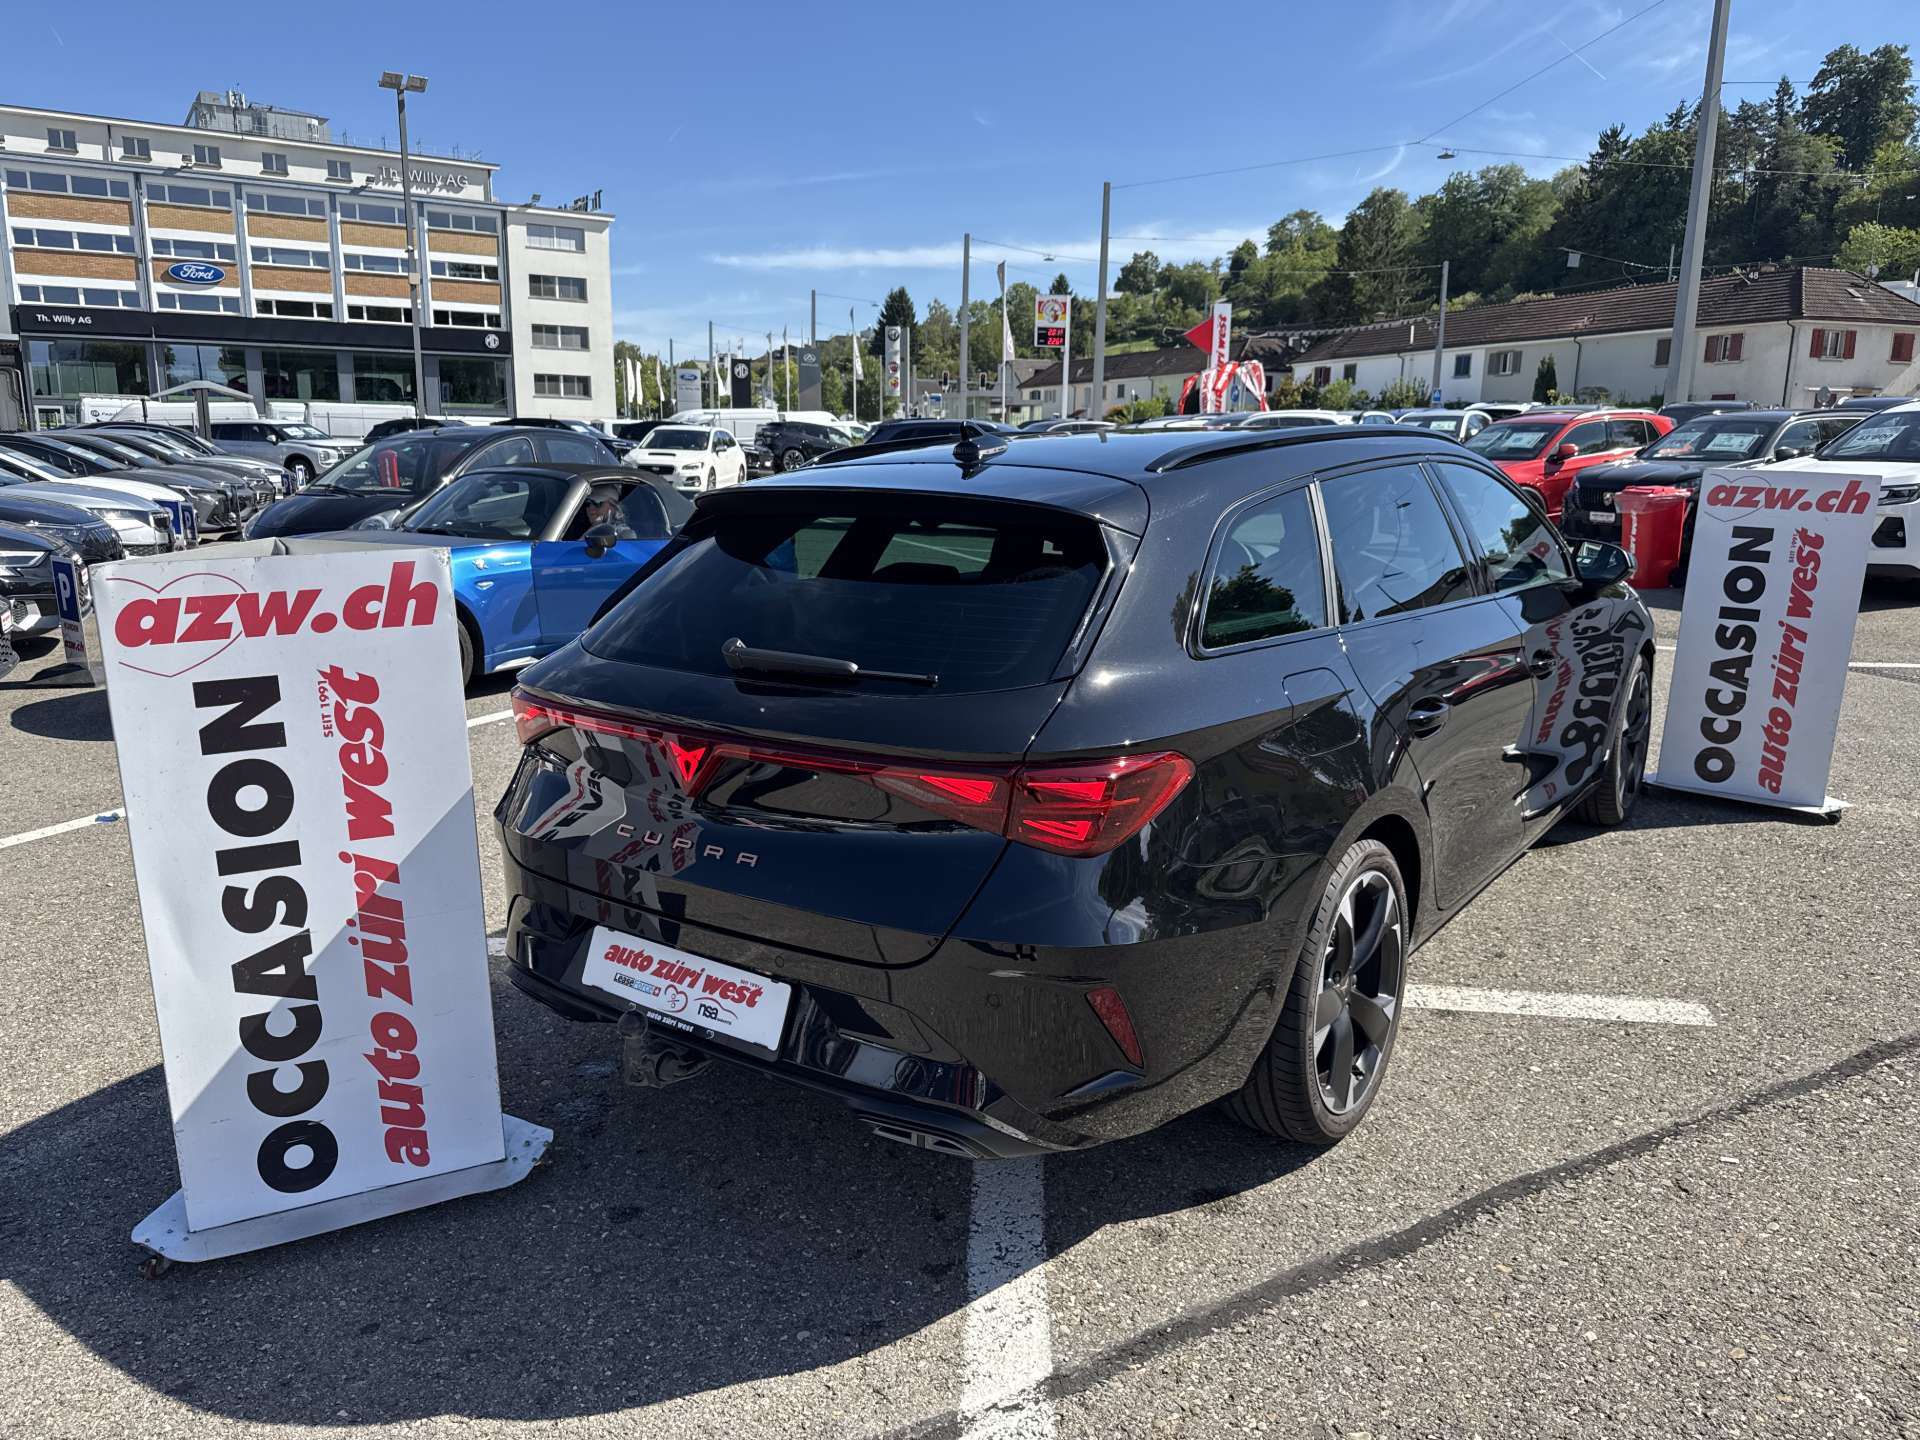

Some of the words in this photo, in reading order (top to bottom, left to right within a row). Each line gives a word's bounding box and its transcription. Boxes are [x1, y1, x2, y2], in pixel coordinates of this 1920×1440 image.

[408, 169, 442, 185] Willy
[446, 173, 469, 187] AG
[180, 264, 215, 280] Ford
[36, 314, 51, 322] Th.
[52, 315, 75, 325] Willy
[78, 316, 92, 324] AG
[1706, 480, 1871, 514] azw.ch
[58, 573, 71, 611] P
[1786, 527, 1824, 618] west
[115, 561, 439, 648] azw.ch
[1694, 526, 1774, 783] OCCASION
[1771, 620, 1808, 708] züri
[317, 680, 330, 708] 1991
[322, 713, 334, 737] SEIT
[1758, 707, 1792, 794] auto
[316, 664, 394, 841] west
[616, 824, 758, 868] CUPRA
[192, 675, 338, 1193] OCCASION
[338, 851, 413, 1006] züri
[604, 944, 653, 972] auto
[650, 959, 706, 989] züri
[702, 975, 764, 1008] west
[646, 1011, 662, 1021] auto
[662, 1016, 677, 1027] züri
[677, 1021, 695, 1032] west
[698, 1003, 718, 1020] nsa
[362, 1012, 430, 1167] auto
